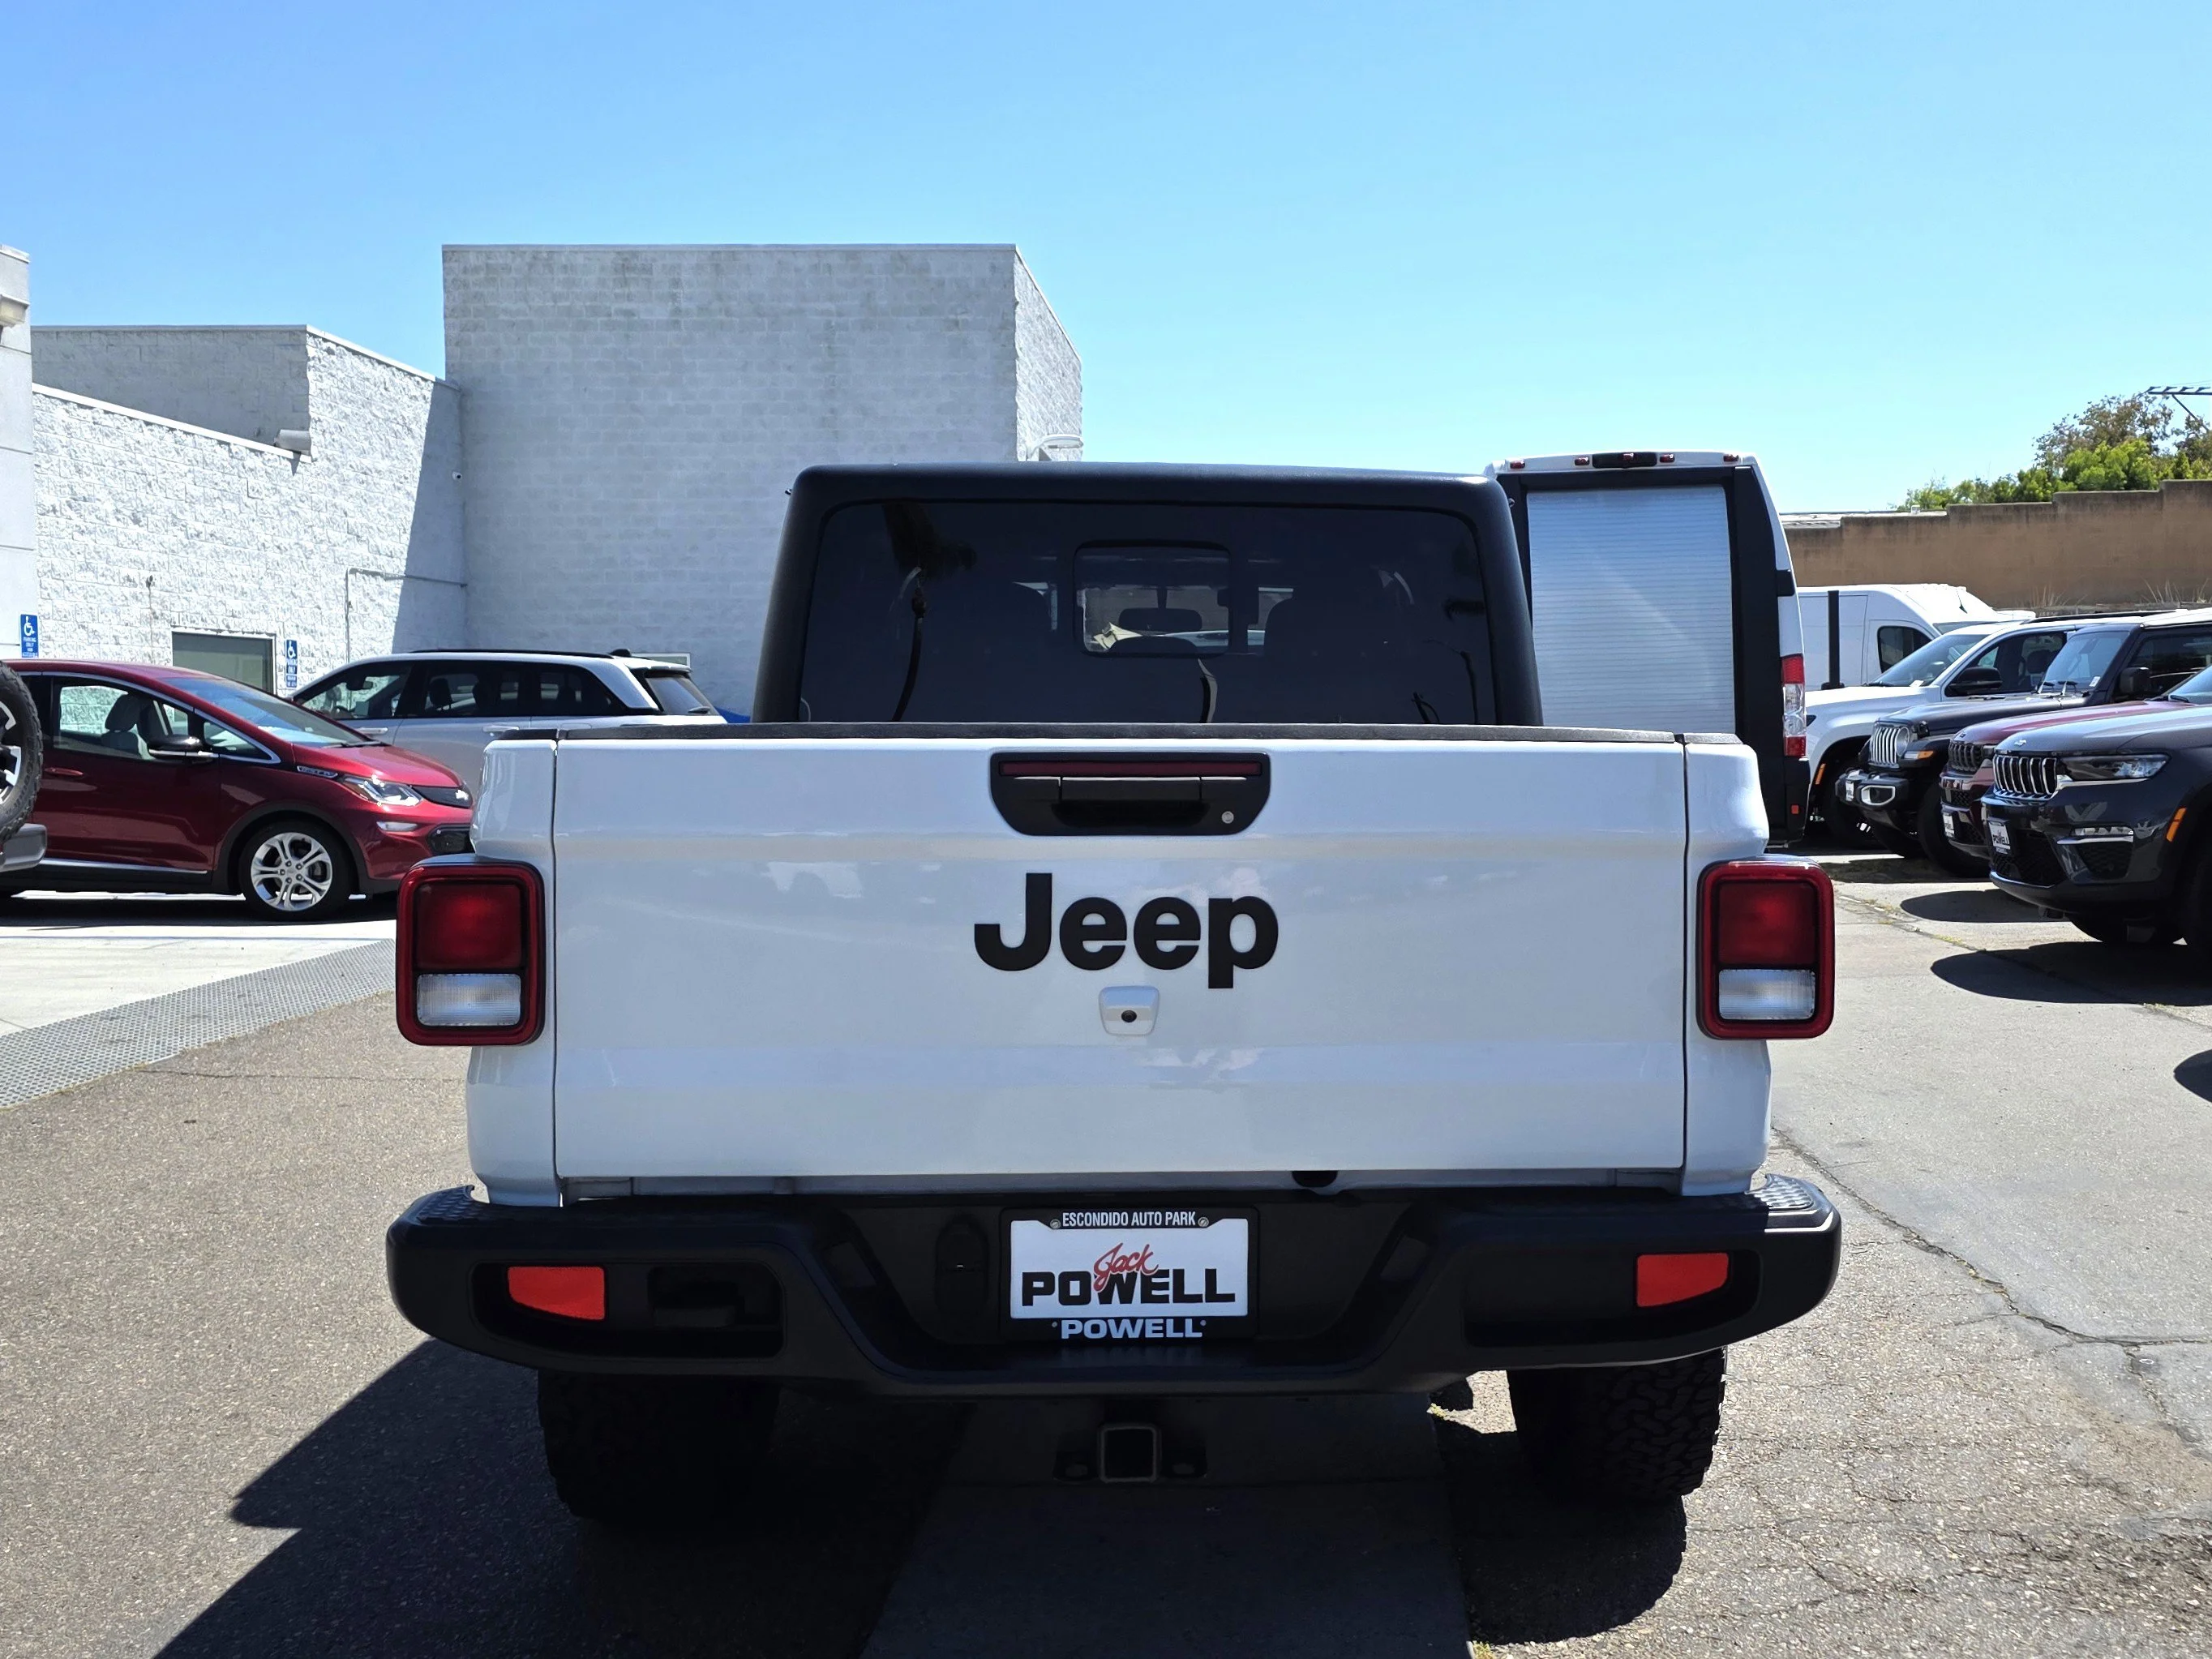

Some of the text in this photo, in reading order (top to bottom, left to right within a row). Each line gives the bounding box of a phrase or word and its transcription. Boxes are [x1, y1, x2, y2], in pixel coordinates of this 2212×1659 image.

[974, 872, 1279, 988] Jeep
[1062, 1211, 1196, 1227] ESCONDIDO AUTO PARK
[1093, 1242, 1159, 1292] Jack
[1022, 1268, 1236, 1307] POWELL
[1061, 1318, 1202, 1340] POWELL
